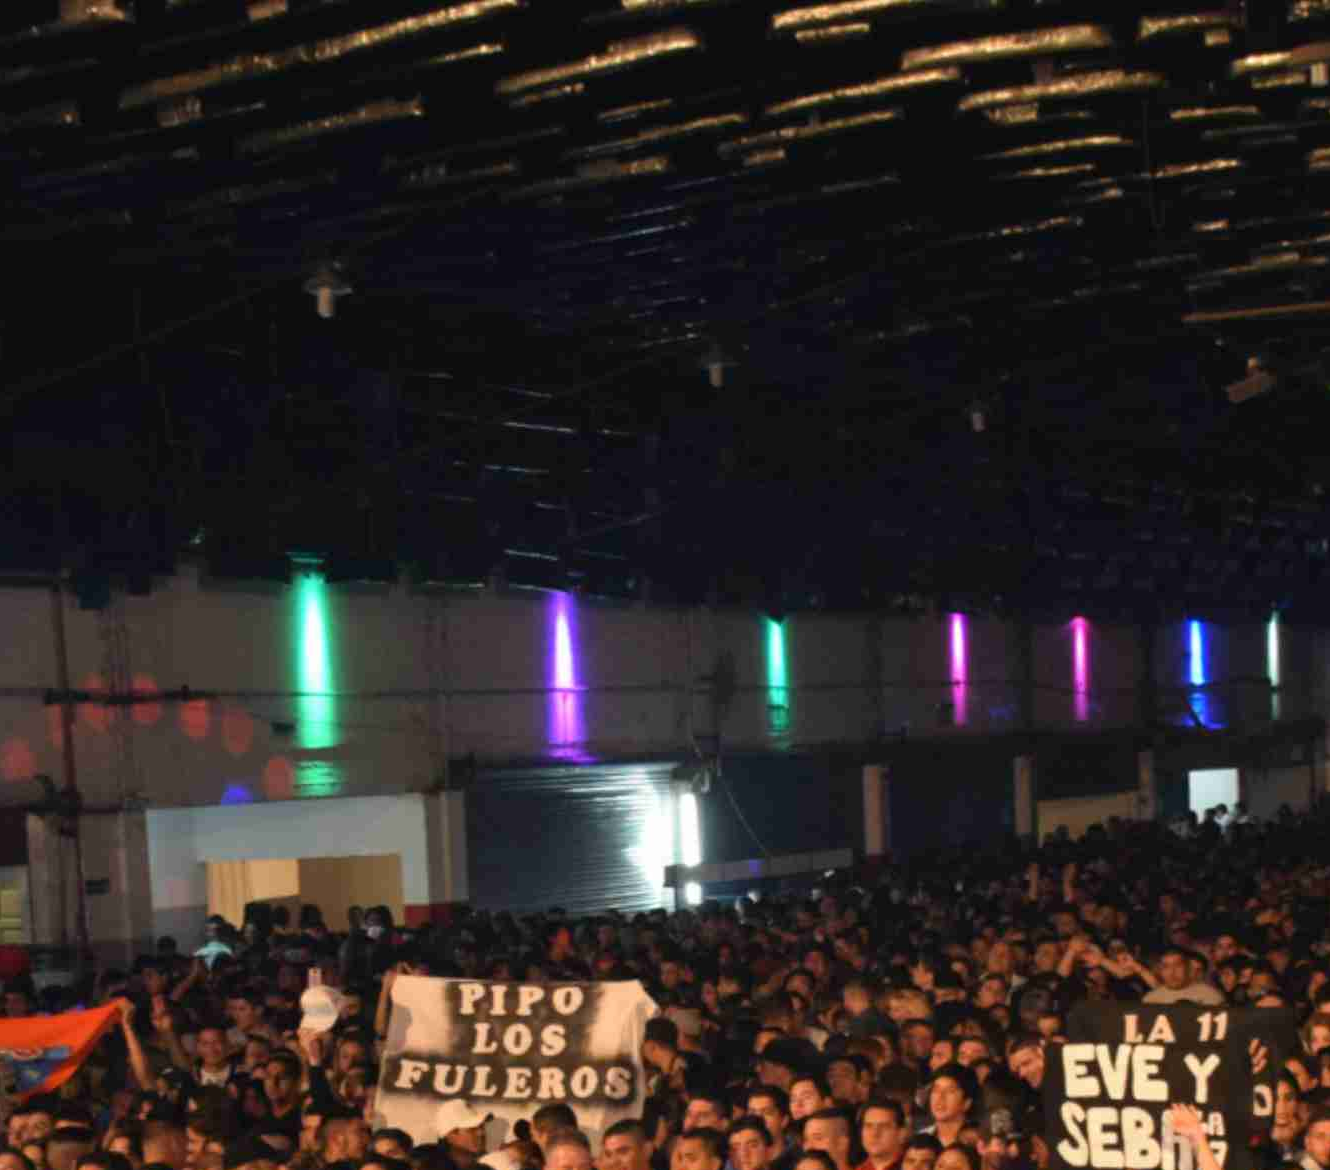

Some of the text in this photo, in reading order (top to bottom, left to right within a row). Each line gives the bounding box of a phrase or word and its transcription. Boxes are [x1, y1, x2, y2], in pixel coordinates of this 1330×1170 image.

[458, 983, 584, 1016] PIPO
[472, 1021, 567, 1056] LOS
[1124, 1011, 1228, 1044] LA 11
[394, 1058, 632, 1099] FULEROS
[1061, 1043, 1221, 1103] EVE Y
